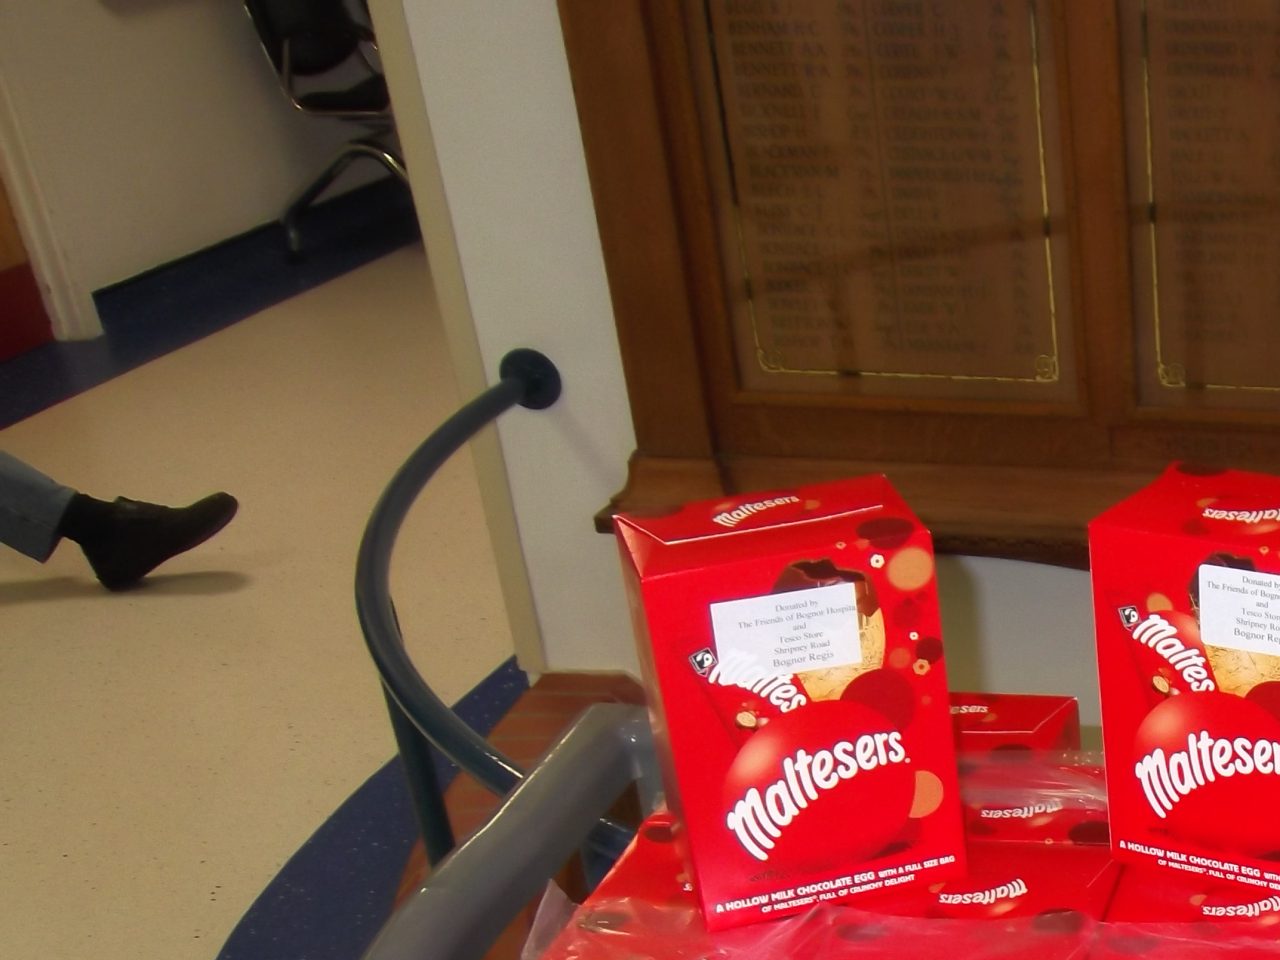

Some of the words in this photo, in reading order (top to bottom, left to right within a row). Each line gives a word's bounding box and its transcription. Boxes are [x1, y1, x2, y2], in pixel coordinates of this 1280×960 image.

[712, 495, 800, 527] Maltesers
[1208, 581, 1220, 590] The
[1222, 584, 1248, 595] Friends
[1242, 576, 1272, 588] Donated
[775, 601, 808, 612] Donated
[1242, 608, 1262, 618] Tesco
[755, 617, 784, 626] Friends
[796, 610, 824, 620] Bognor
[1236, 618, 1268, 630] Shripney
[780, 635, 801, 643] Tesco
[803, 631, 823, 639] Store
[1234, 628, 1264, 640] Bognor
[774, 646, 808, 655] Shripney
[810, 640, 830, 649] Road
[1133, 614, 1215, 693] Maltes
[773, 656, 806, 668] Bognor
[809, 652, 834, 662] Regis
[727, 732, 908, 861] Maltesers
[981, 799, 1063, 818] Maltesers
[1120, 840, 1126, 848] A
[1128, 842, 1164, 857] HOLLOW
[1166, 850, 1188, 862] MILK
[1189, 854, 1240, 872] CHOCOLATE
[1241, 866, 1260, 876] EGG
[716, 904, 724, 912] A
[726, 895, 769, 911] HOLLOW
[771, 890, 794, 900] MILK
[797, 876, 852, 895] CHOCOLATE
[854, 872, 875, 883] EGG
[878, 868, 897, 878] WITH
[898, 866, 904, 874] A
[905, 863, 922, 872] FULL
[885, 874, 915, 886] DELIGHT
[939, 878, 1028, 905] Maltesers
